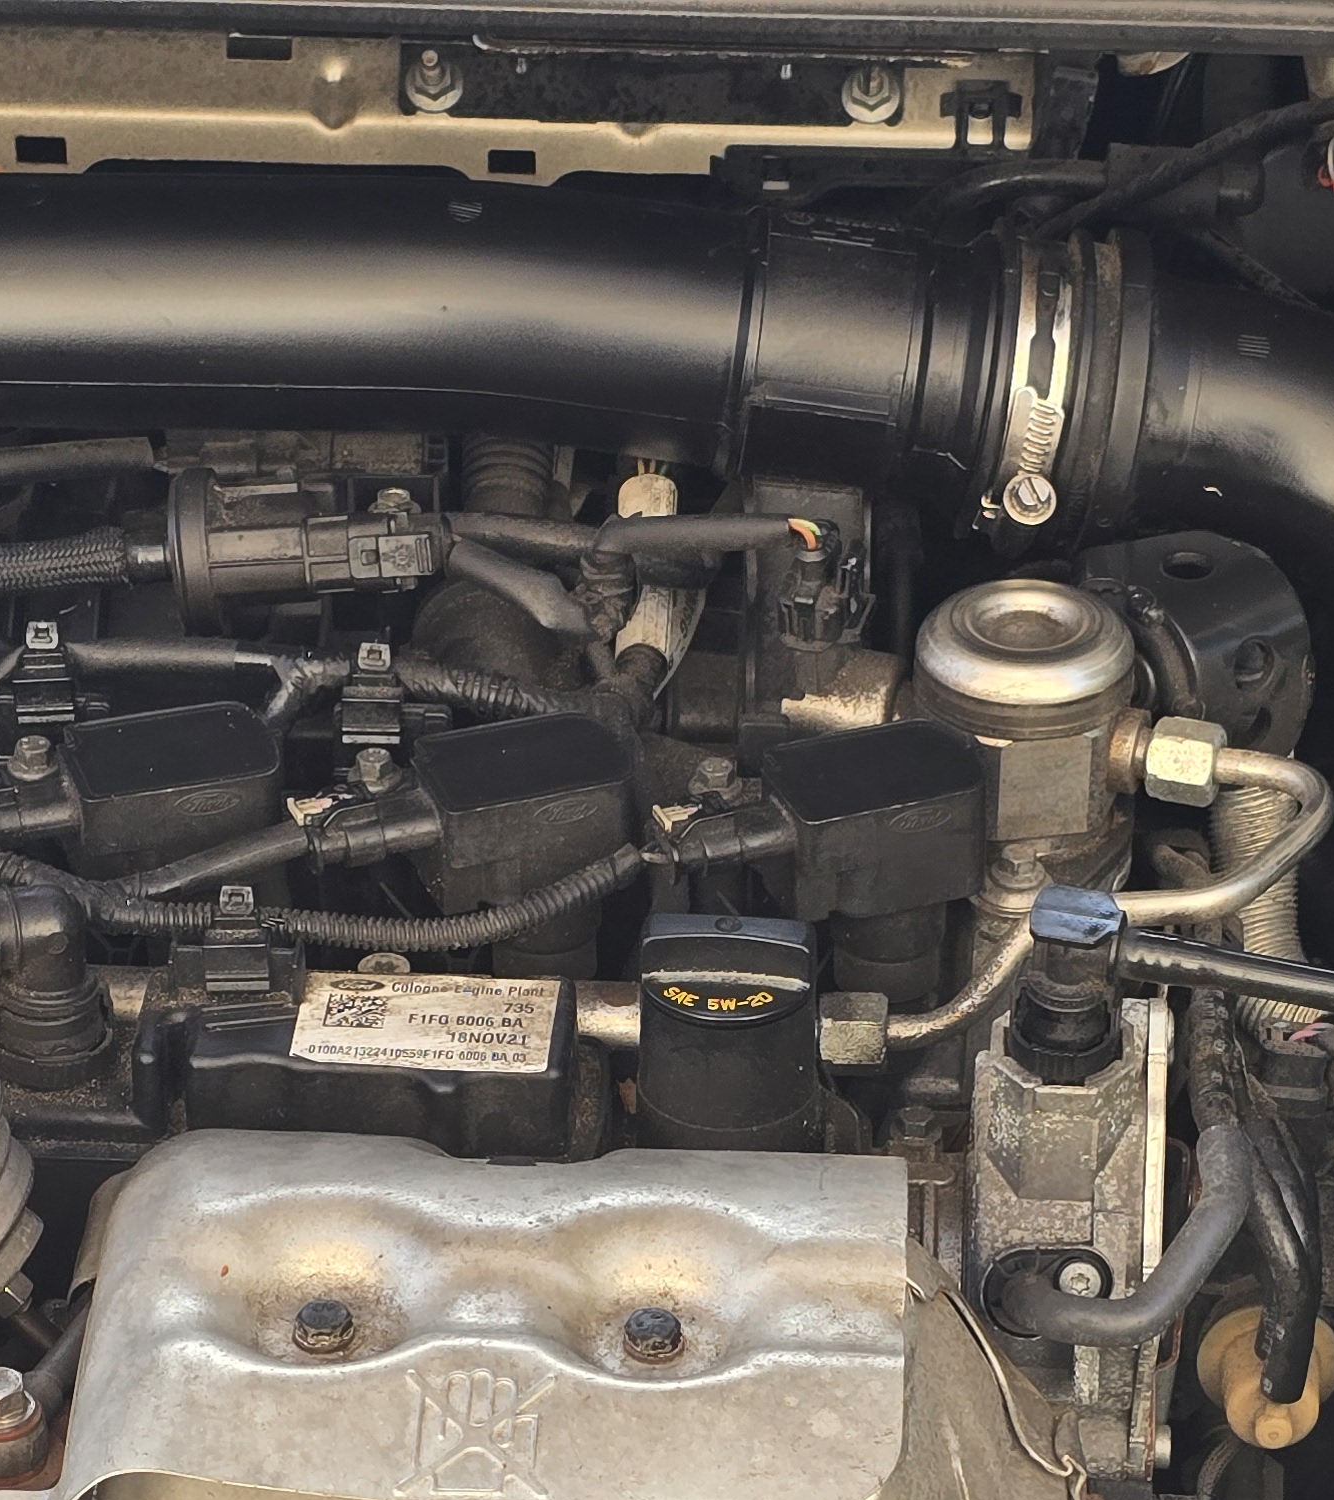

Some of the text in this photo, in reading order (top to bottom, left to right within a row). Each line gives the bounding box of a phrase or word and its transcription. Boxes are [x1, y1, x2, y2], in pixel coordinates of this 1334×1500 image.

[508, 986, 545, 997] Plant
[663, 986, 774, 1012] SAE 5W-20
[503, 1002, 535, 1014] 735
[501, 1017, 524, 1029] BA
[448, 1031, 528, 1046] 18NOV21
